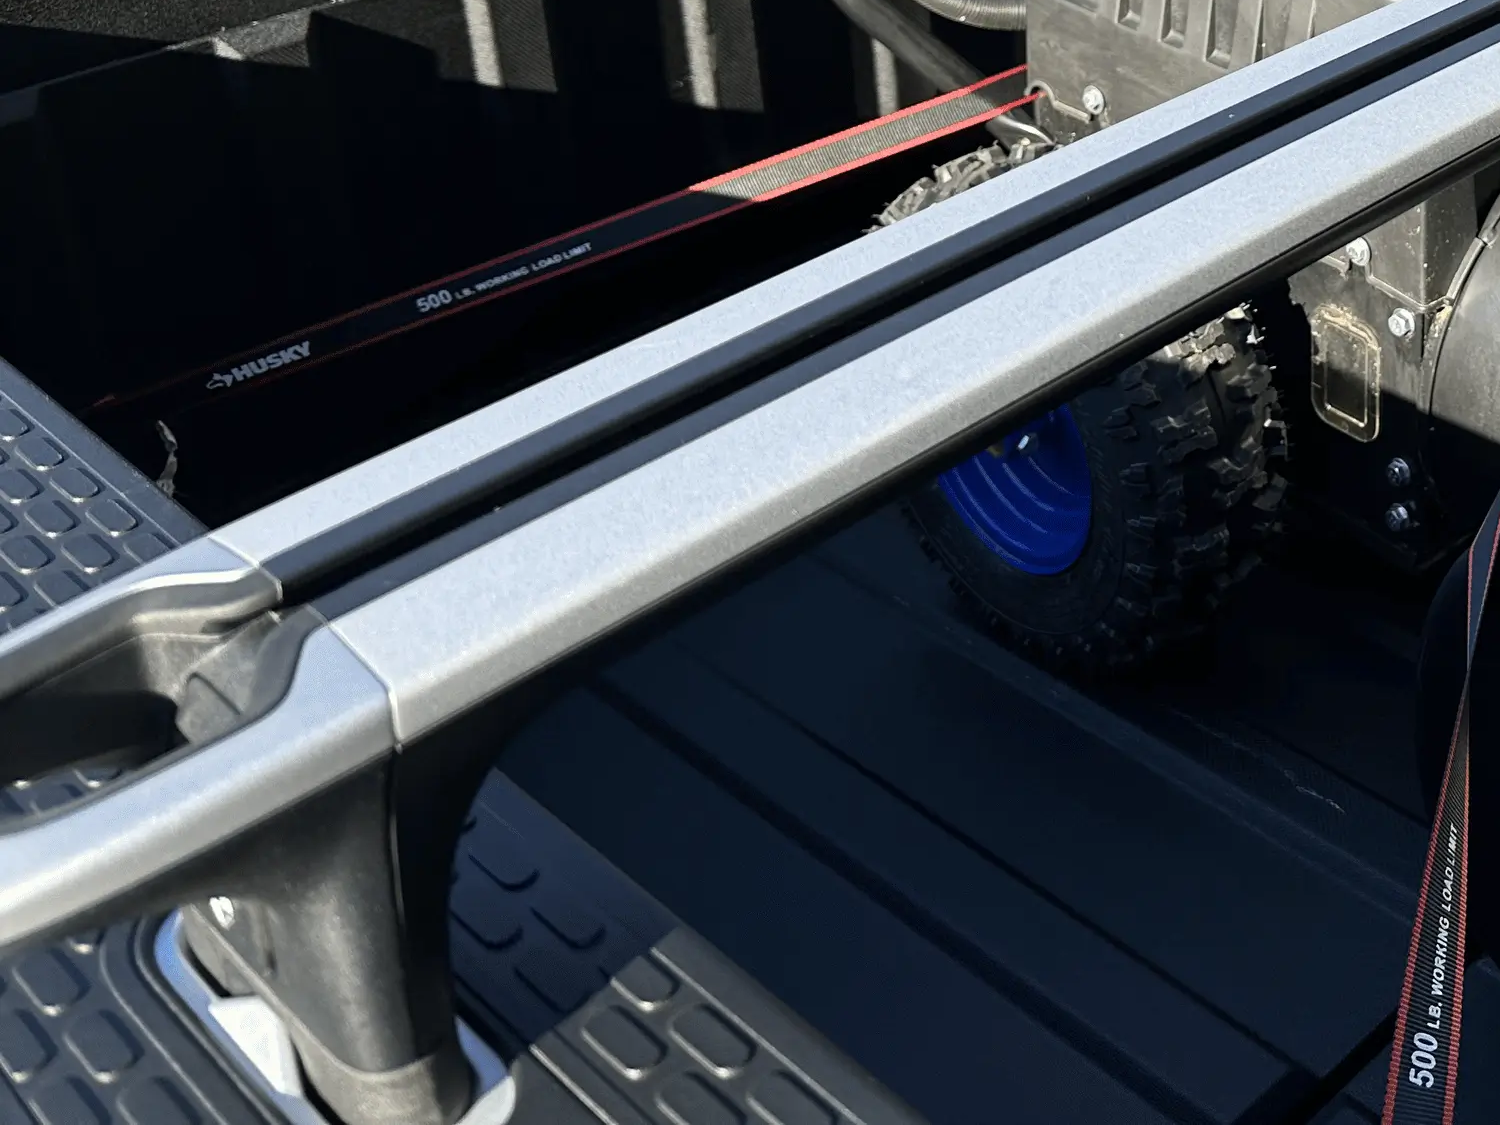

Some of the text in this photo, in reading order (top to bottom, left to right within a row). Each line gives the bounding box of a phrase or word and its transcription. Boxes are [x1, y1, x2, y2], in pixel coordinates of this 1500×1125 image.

[415, 289, 453, 313] 500
[475, 265, 531, 292] WORKING
[531, 253, 563, 272] LOAD
[562, 241, 593, 261] LIMIT
[230, 340, 311, 382] HUSKY
[1408, 822, 1458, 1089] 500 LB. WORKING LOAD LIMIT
